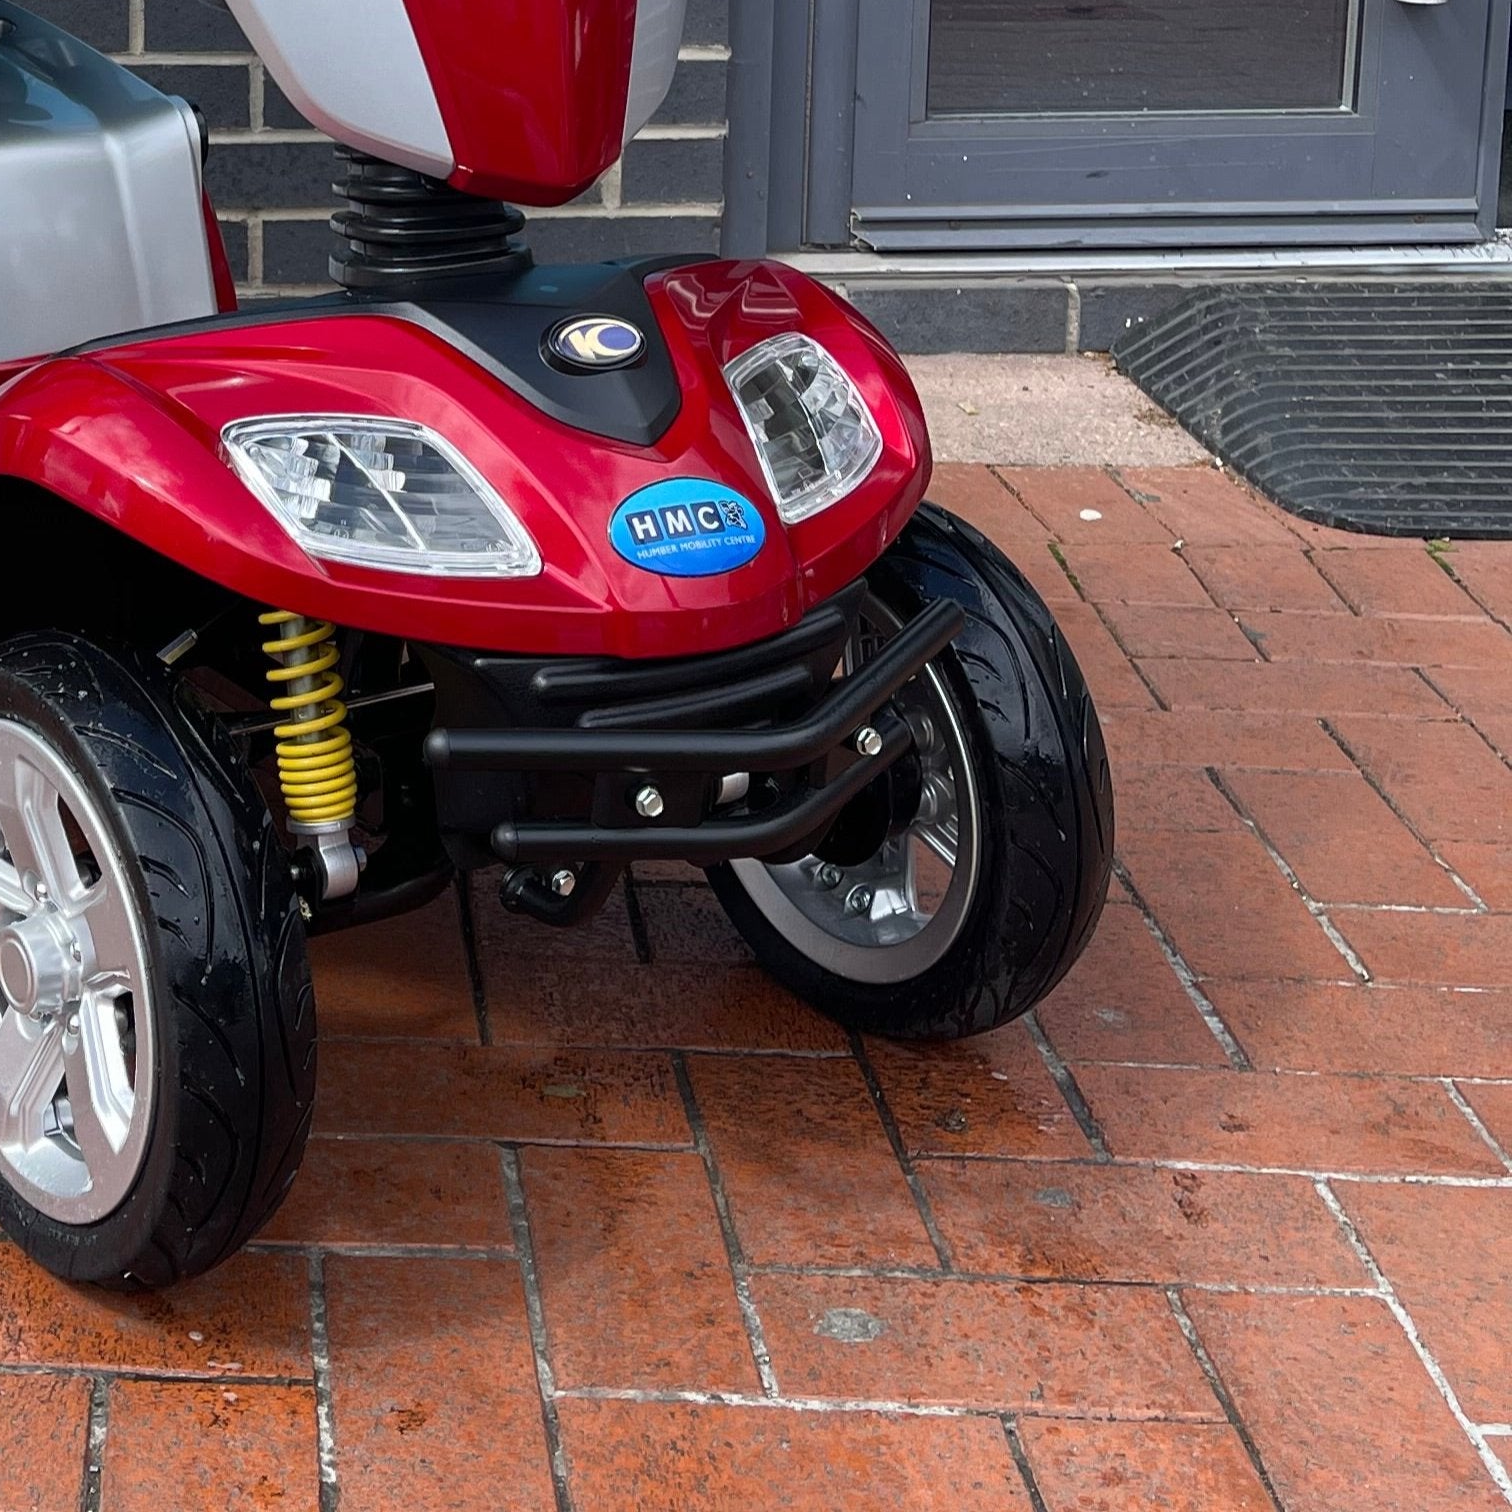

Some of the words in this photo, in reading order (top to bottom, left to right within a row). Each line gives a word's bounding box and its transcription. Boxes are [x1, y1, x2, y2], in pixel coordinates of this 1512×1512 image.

[631, 506, 720, 540] HMC
[637, 544, 678, 560] HUMBER
[679, 538, 723, 552] MOBILITY
[723, 534, 757, 547] CENTRE
